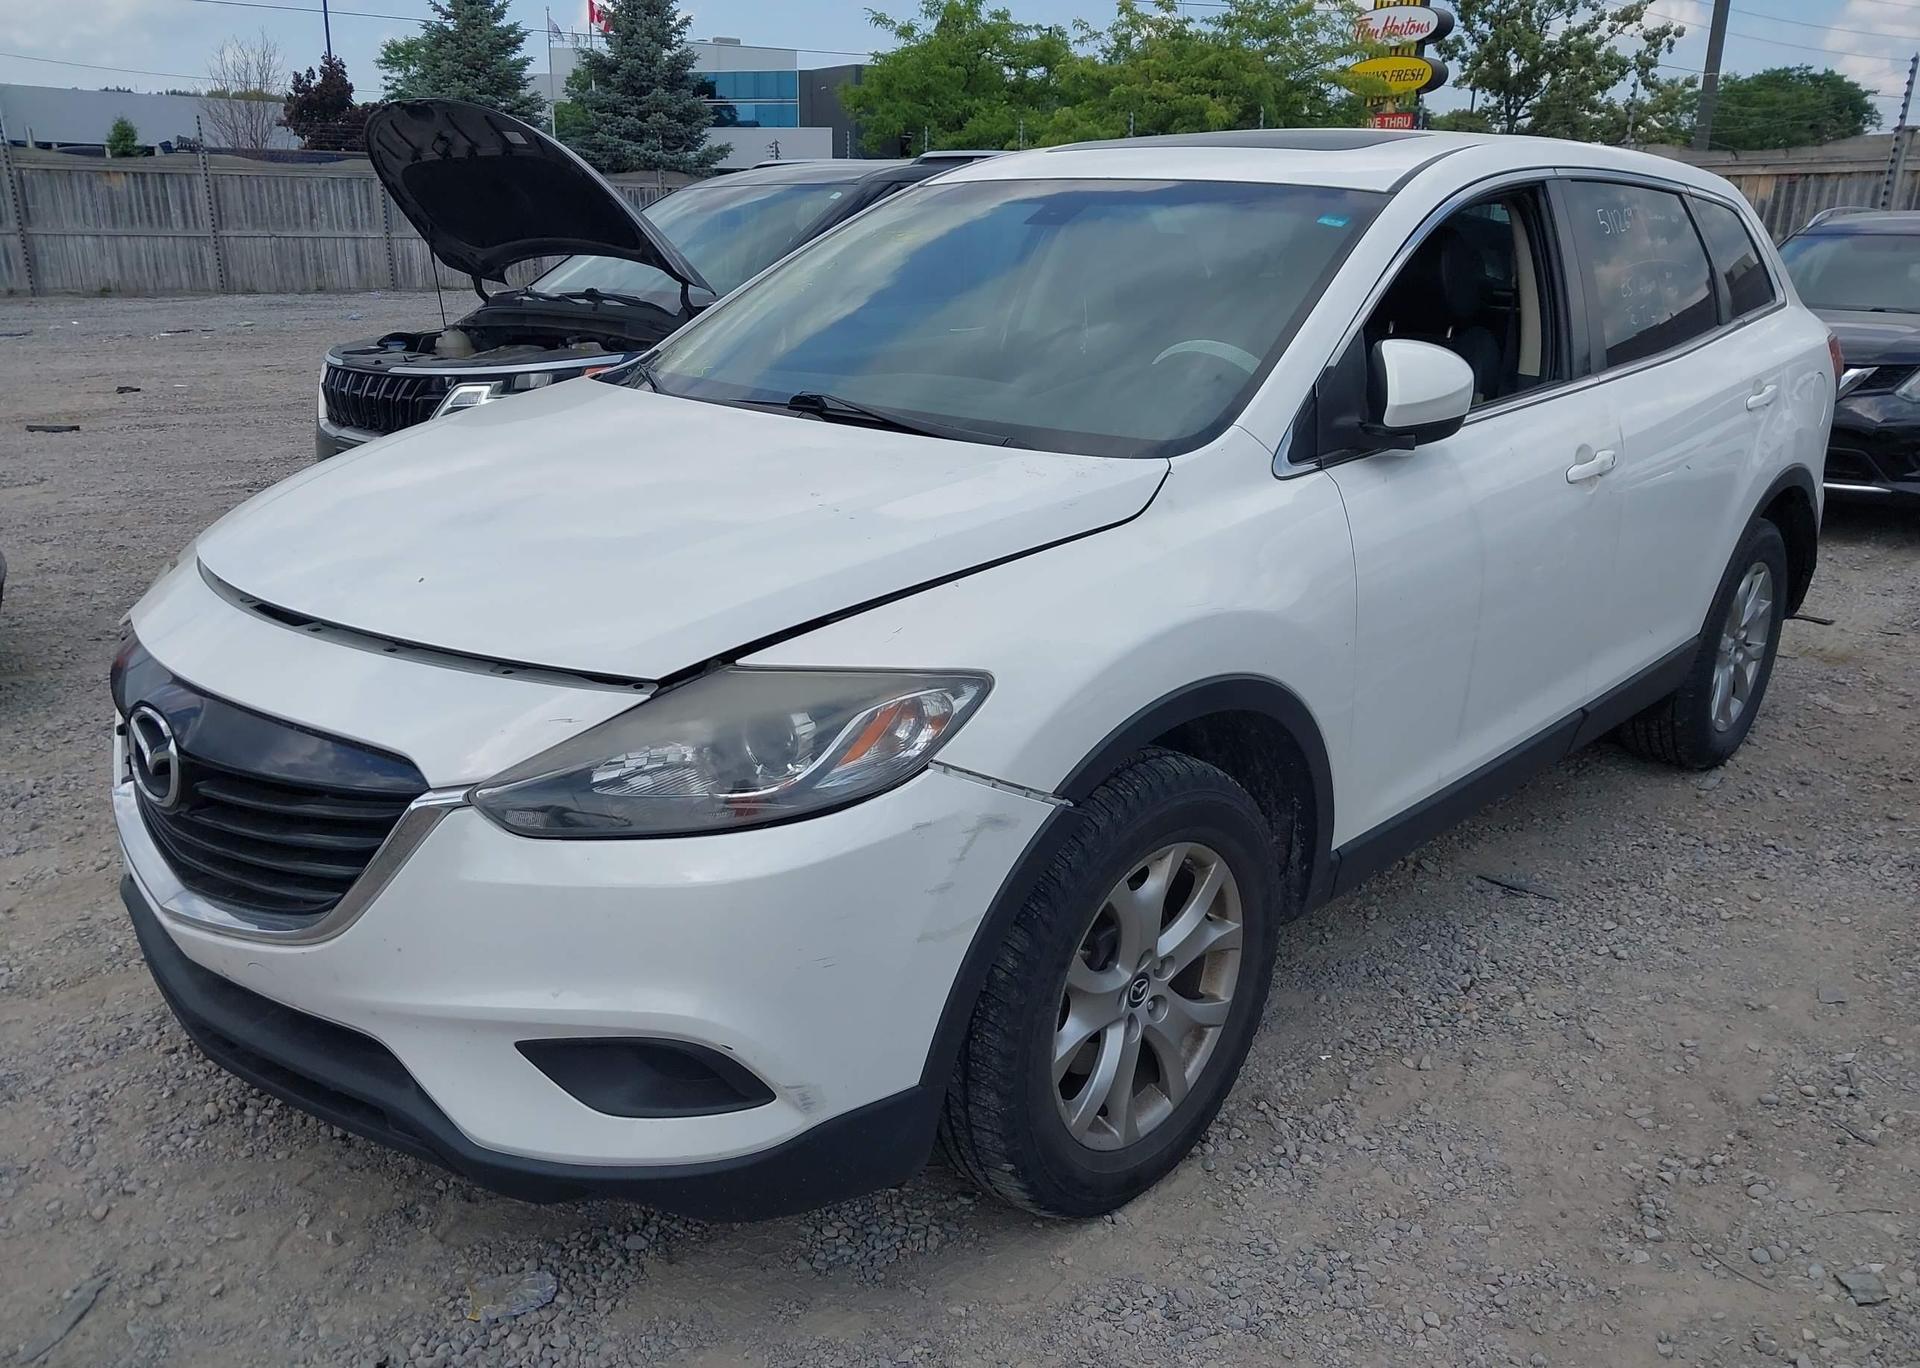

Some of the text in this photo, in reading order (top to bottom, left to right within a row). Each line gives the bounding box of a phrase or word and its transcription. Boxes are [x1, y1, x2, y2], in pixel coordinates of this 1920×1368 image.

[1380, 15, 1430, 39] Hortons
[1388, 68, 1426, 82] FRESH
[1383, 116, 1411, 128] THRU
